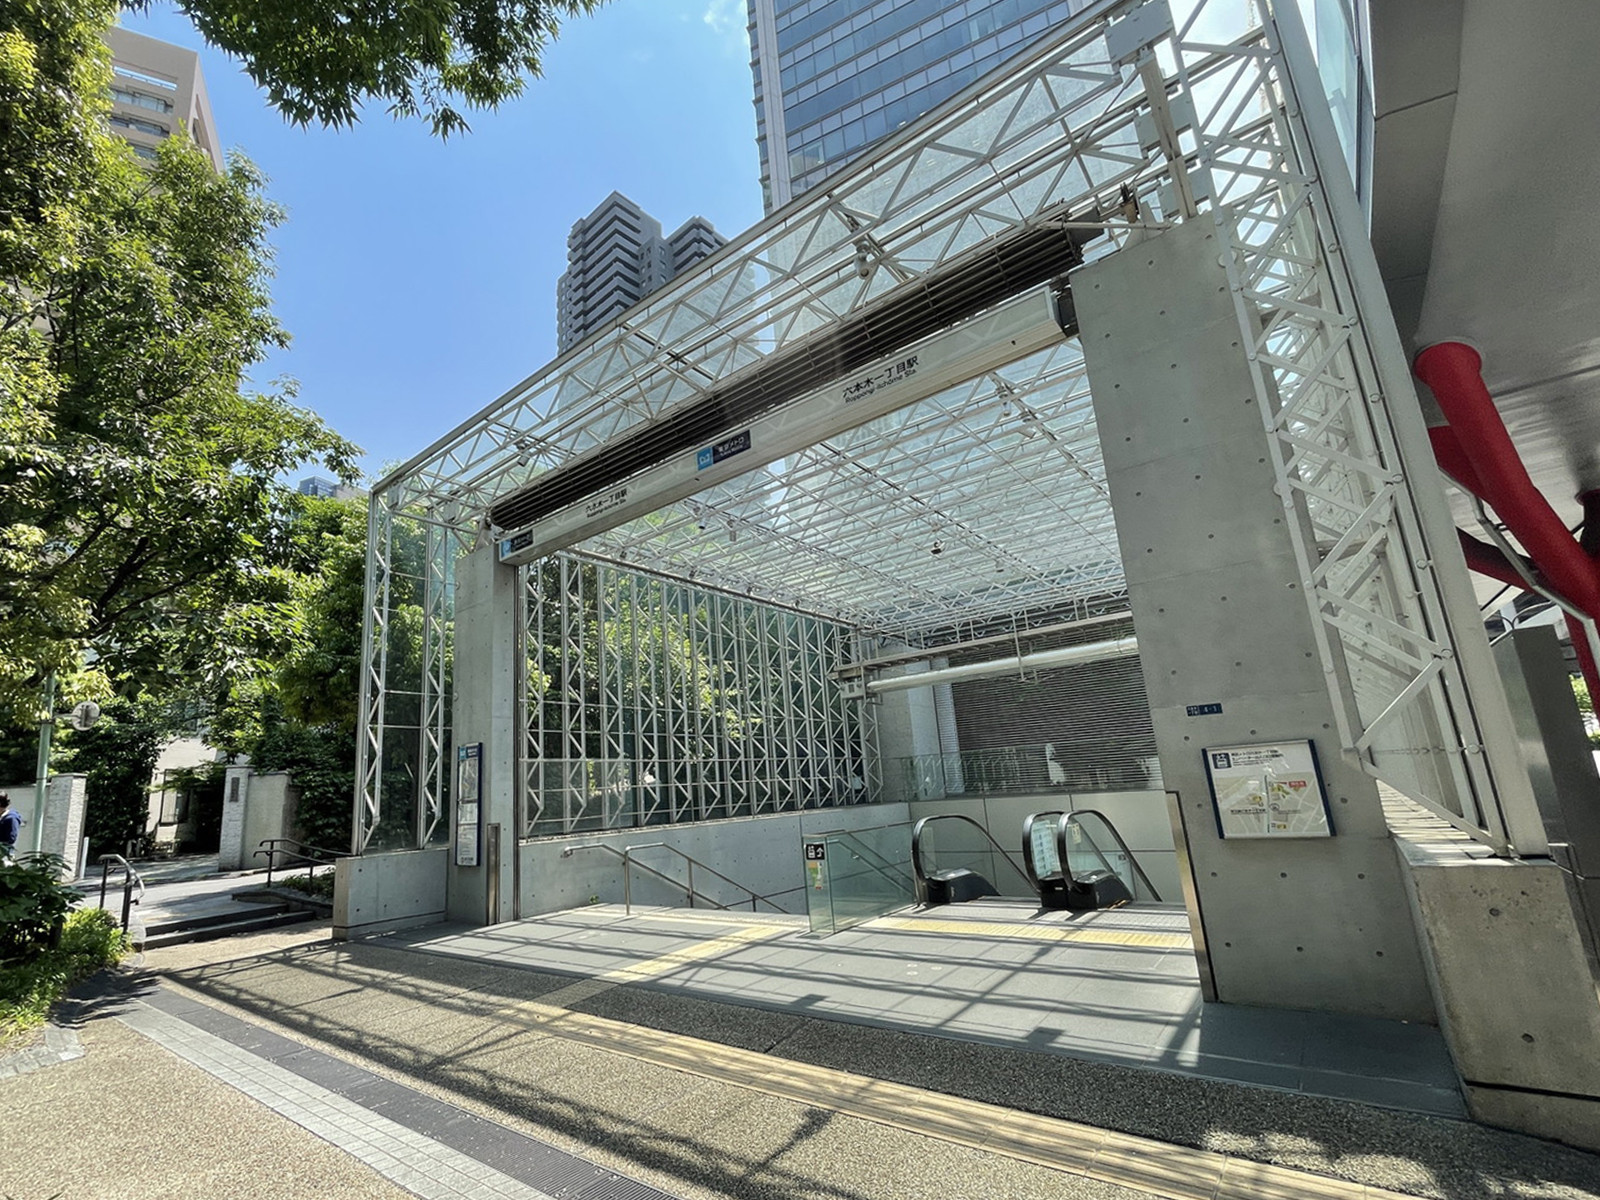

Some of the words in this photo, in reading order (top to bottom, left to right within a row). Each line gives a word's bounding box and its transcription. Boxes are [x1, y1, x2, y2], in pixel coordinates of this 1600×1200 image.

[842, 355, 918, 397] 六本木一丁目駅
[718, 436, 744, 451] 東京メトロ
[586, 488, 627, 512] 六本木一丁目駅
